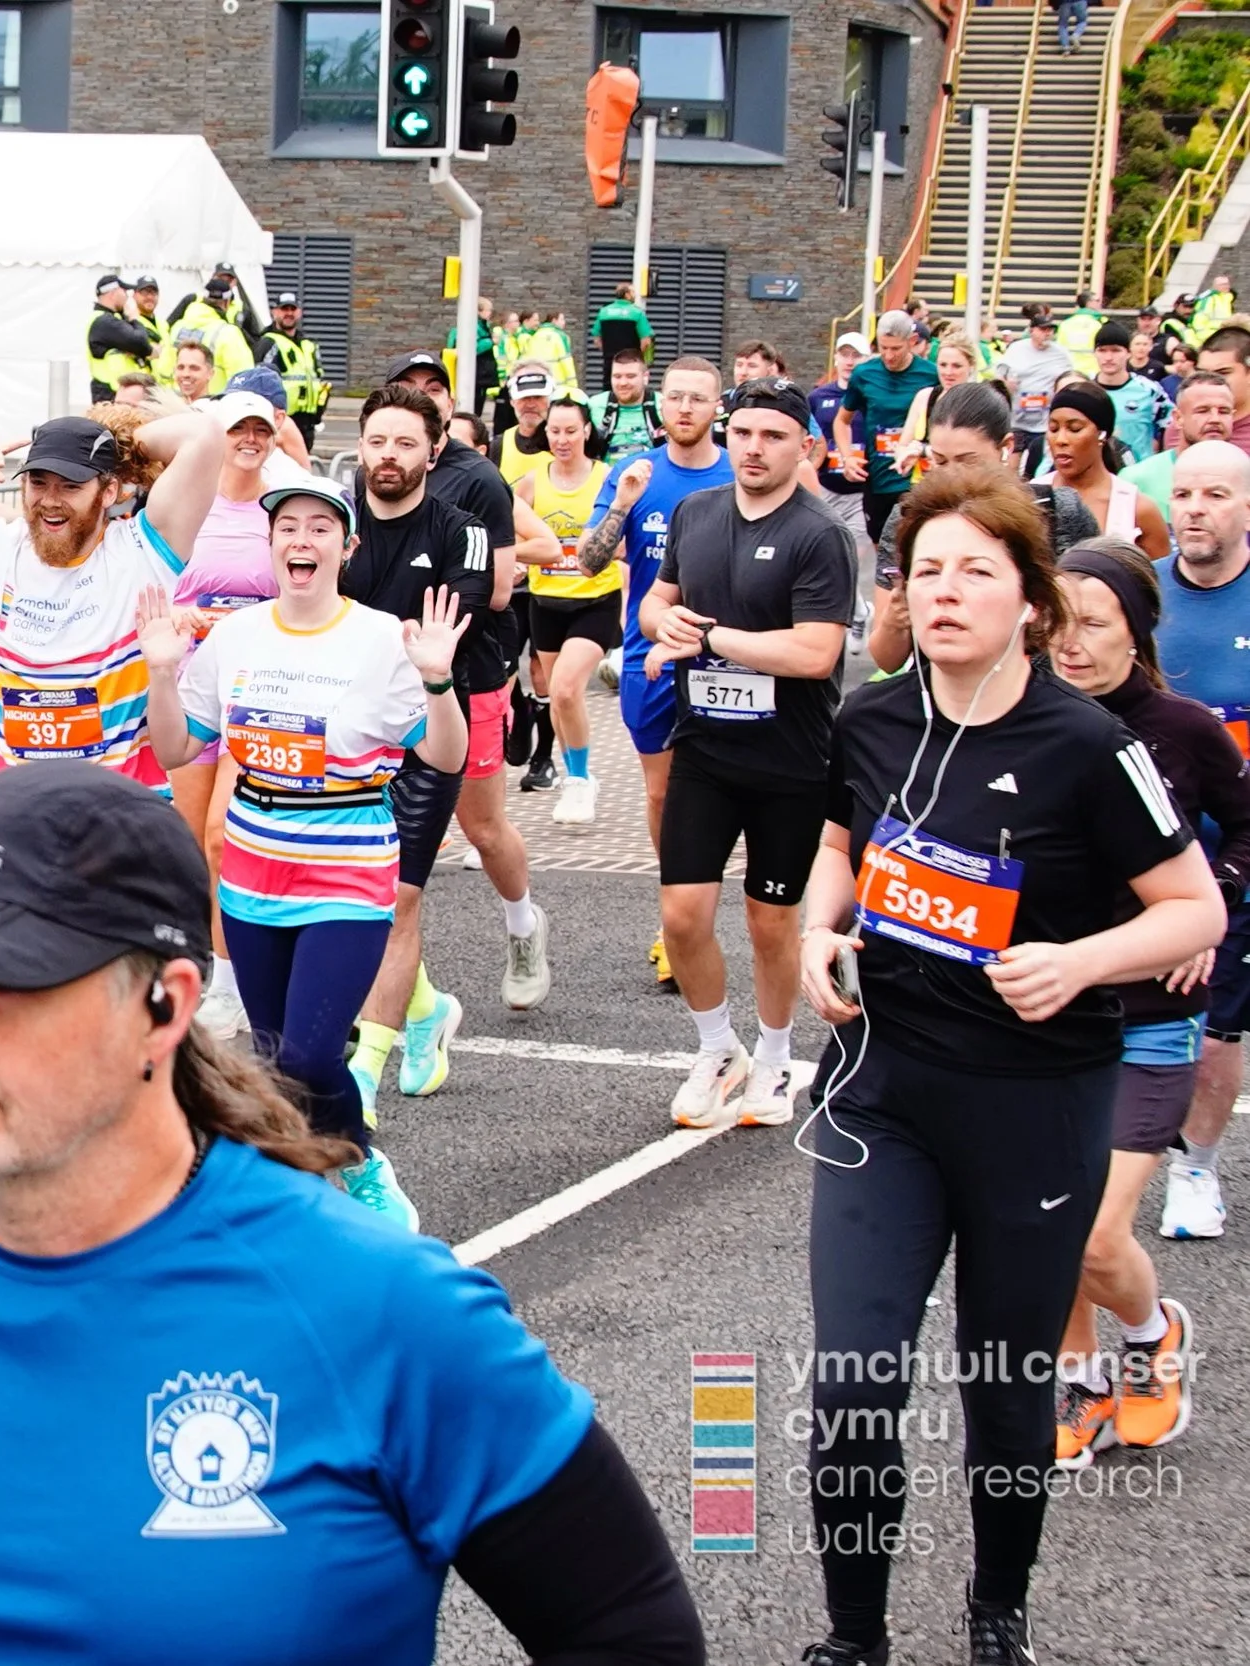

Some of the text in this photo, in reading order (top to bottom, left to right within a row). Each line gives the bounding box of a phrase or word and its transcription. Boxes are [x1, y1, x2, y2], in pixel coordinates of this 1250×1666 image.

[253, 668, 353, 687] ymchwil canser
[690, 674, 718, 684] JAMIE
[248, 682, 289, 695] cymru
[707, 686, 754, 708] 5771
[4, 709, 56, 722] NICHOLAS
[27, 723, 72, 746] 397
[227, 728, 270, 744] BETHAN
[245, 742, 303, 774] 2393
[882, 879, 980, 940] 5934
[153, 1450, 191, 1503] ULTRA
